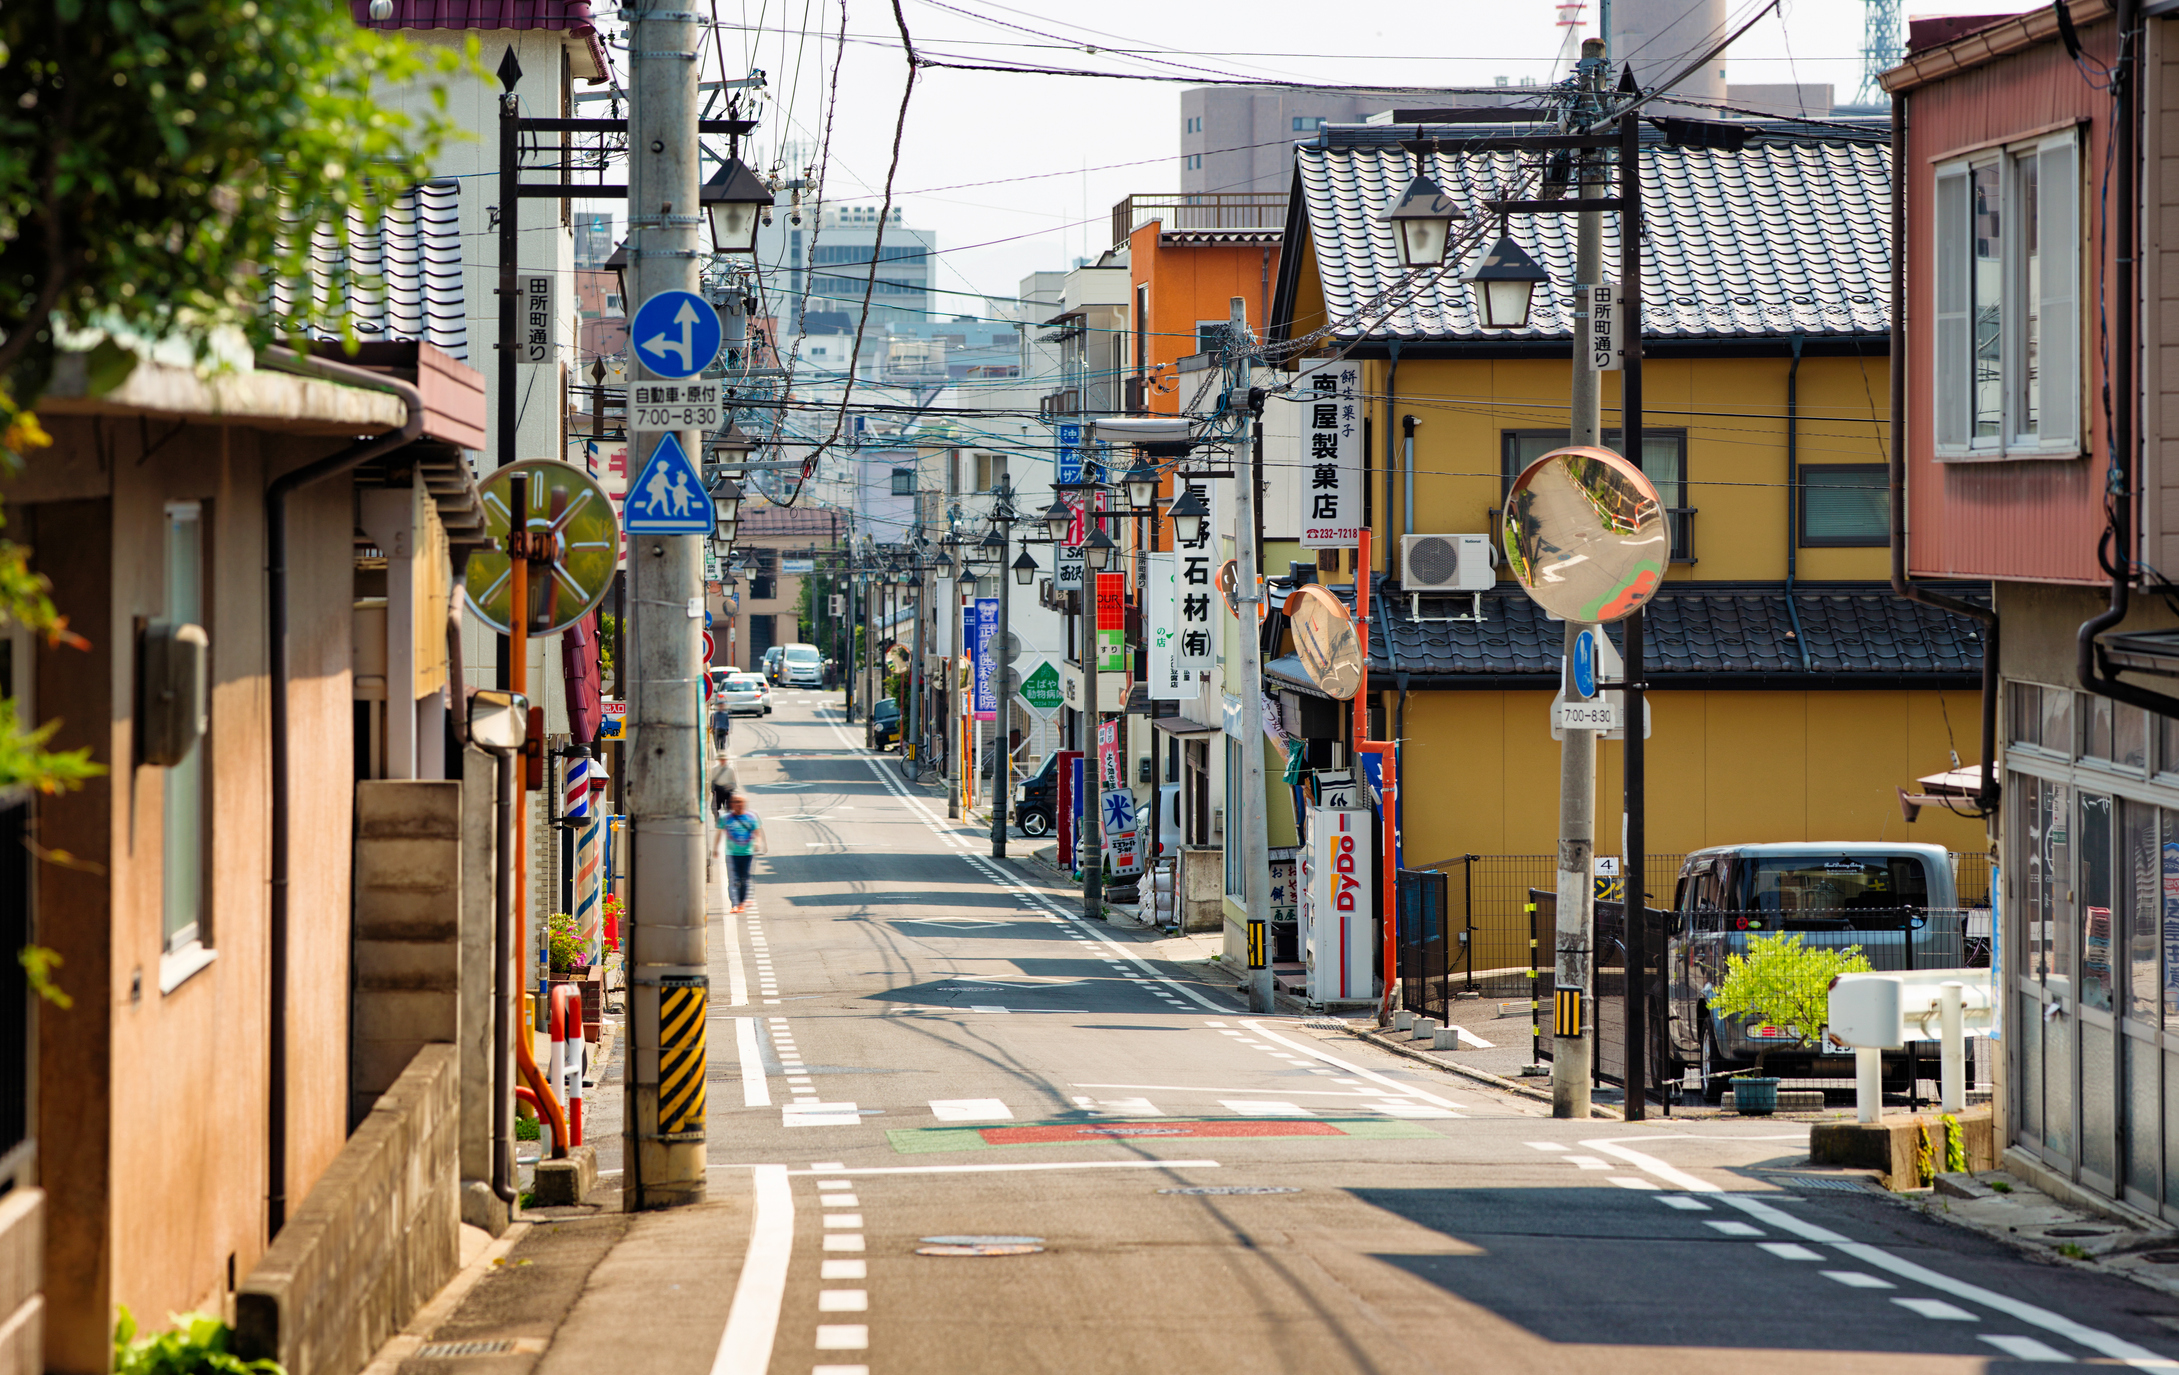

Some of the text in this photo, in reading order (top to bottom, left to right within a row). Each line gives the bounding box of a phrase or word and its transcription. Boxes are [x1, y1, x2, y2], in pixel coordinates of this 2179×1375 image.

[529, 278, 548, 361] 田所町通り
[1594, 287, 1612, 368] 田所町通り
[636, 385, 716, 404] 自動車・原付
[637, 407, 716, 426] 7:00-8:30
[1311, 373, 1339, 520] 南屋製菓店
[1319, 528, 1358, 540] 232-7218
[1026, 678, 1057, 689] こばや
[1565, 709, 1610, 723] 7:00-8:30
[1104, 793, 1134, 830] 米
[1337, 835, 1360, 912] DyDo
[1600, 859, 1613, 870] 4
